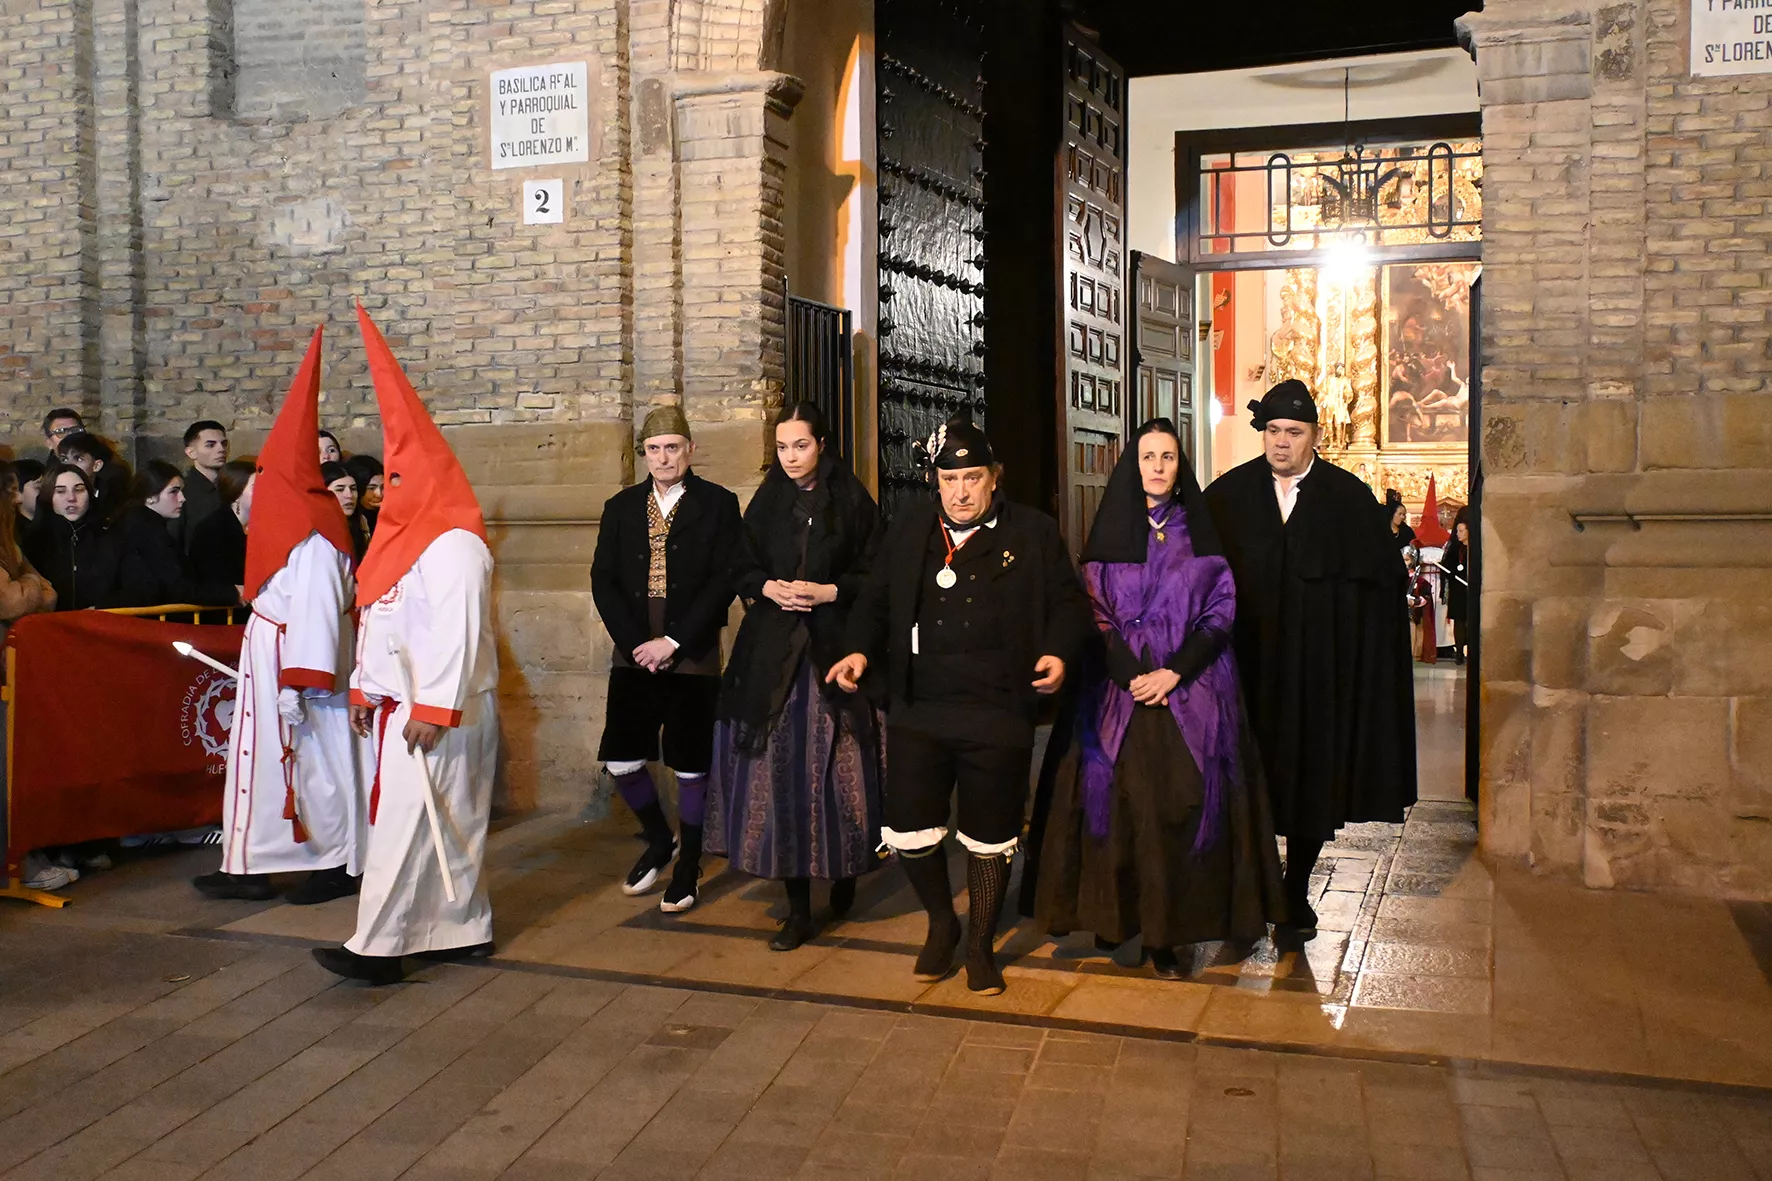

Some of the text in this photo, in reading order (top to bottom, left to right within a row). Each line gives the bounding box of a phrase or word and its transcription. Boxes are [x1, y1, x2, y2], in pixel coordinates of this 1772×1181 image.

[499, 94, 577, 116] Y PARROQUIAL
[531, 117, 545, 134] DE
[512, 137, 562, 157] LORENZO
[534, 188, 550, 214] 2
[196, 669, 211, 685] DE
